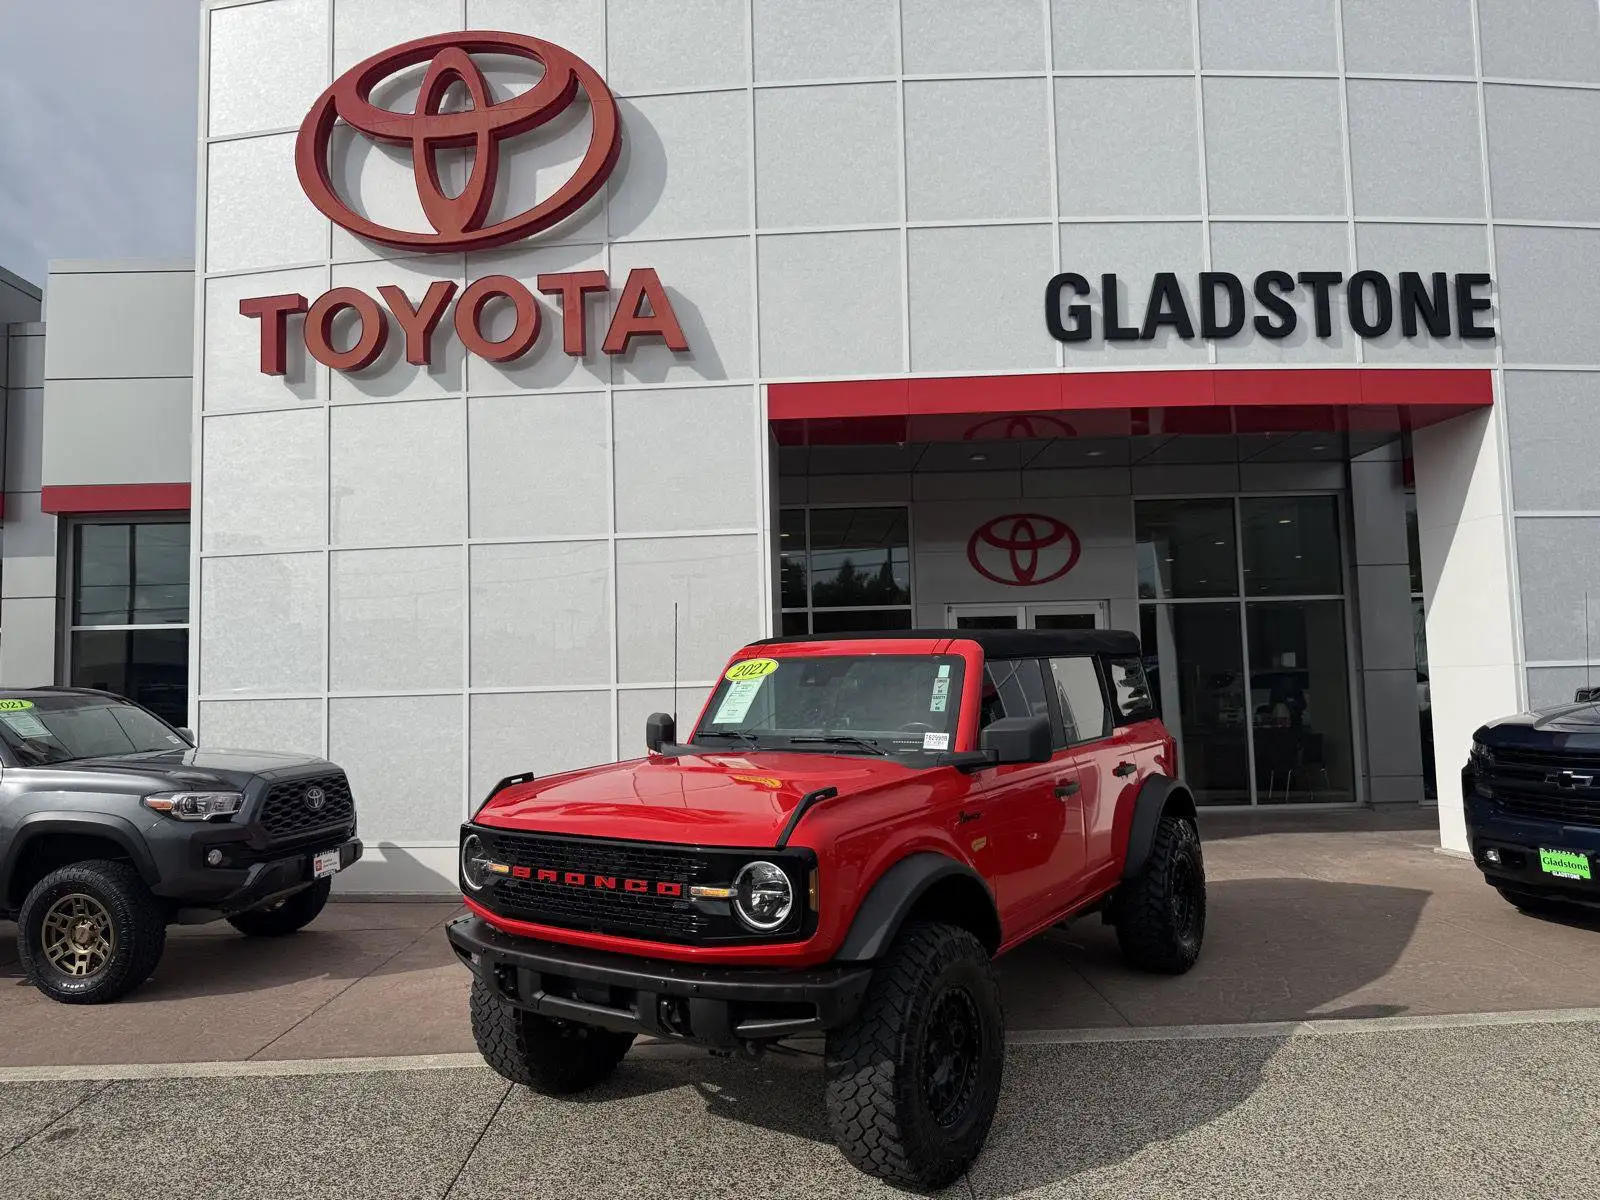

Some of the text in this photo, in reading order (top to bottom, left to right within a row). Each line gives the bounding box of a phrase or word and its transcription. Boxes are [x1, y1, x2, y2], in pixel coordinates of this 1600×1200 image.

[1045, 270, 1496, 342] GLADSTONE
[239, 267, 690, 377] TOYOTA
[731, 661, 773, 678] 2021
[0, 700, 25, 710] 021
[1542, 856, 1589, 872] Gladstone
[512, 865, 682, 897] BRONCO
